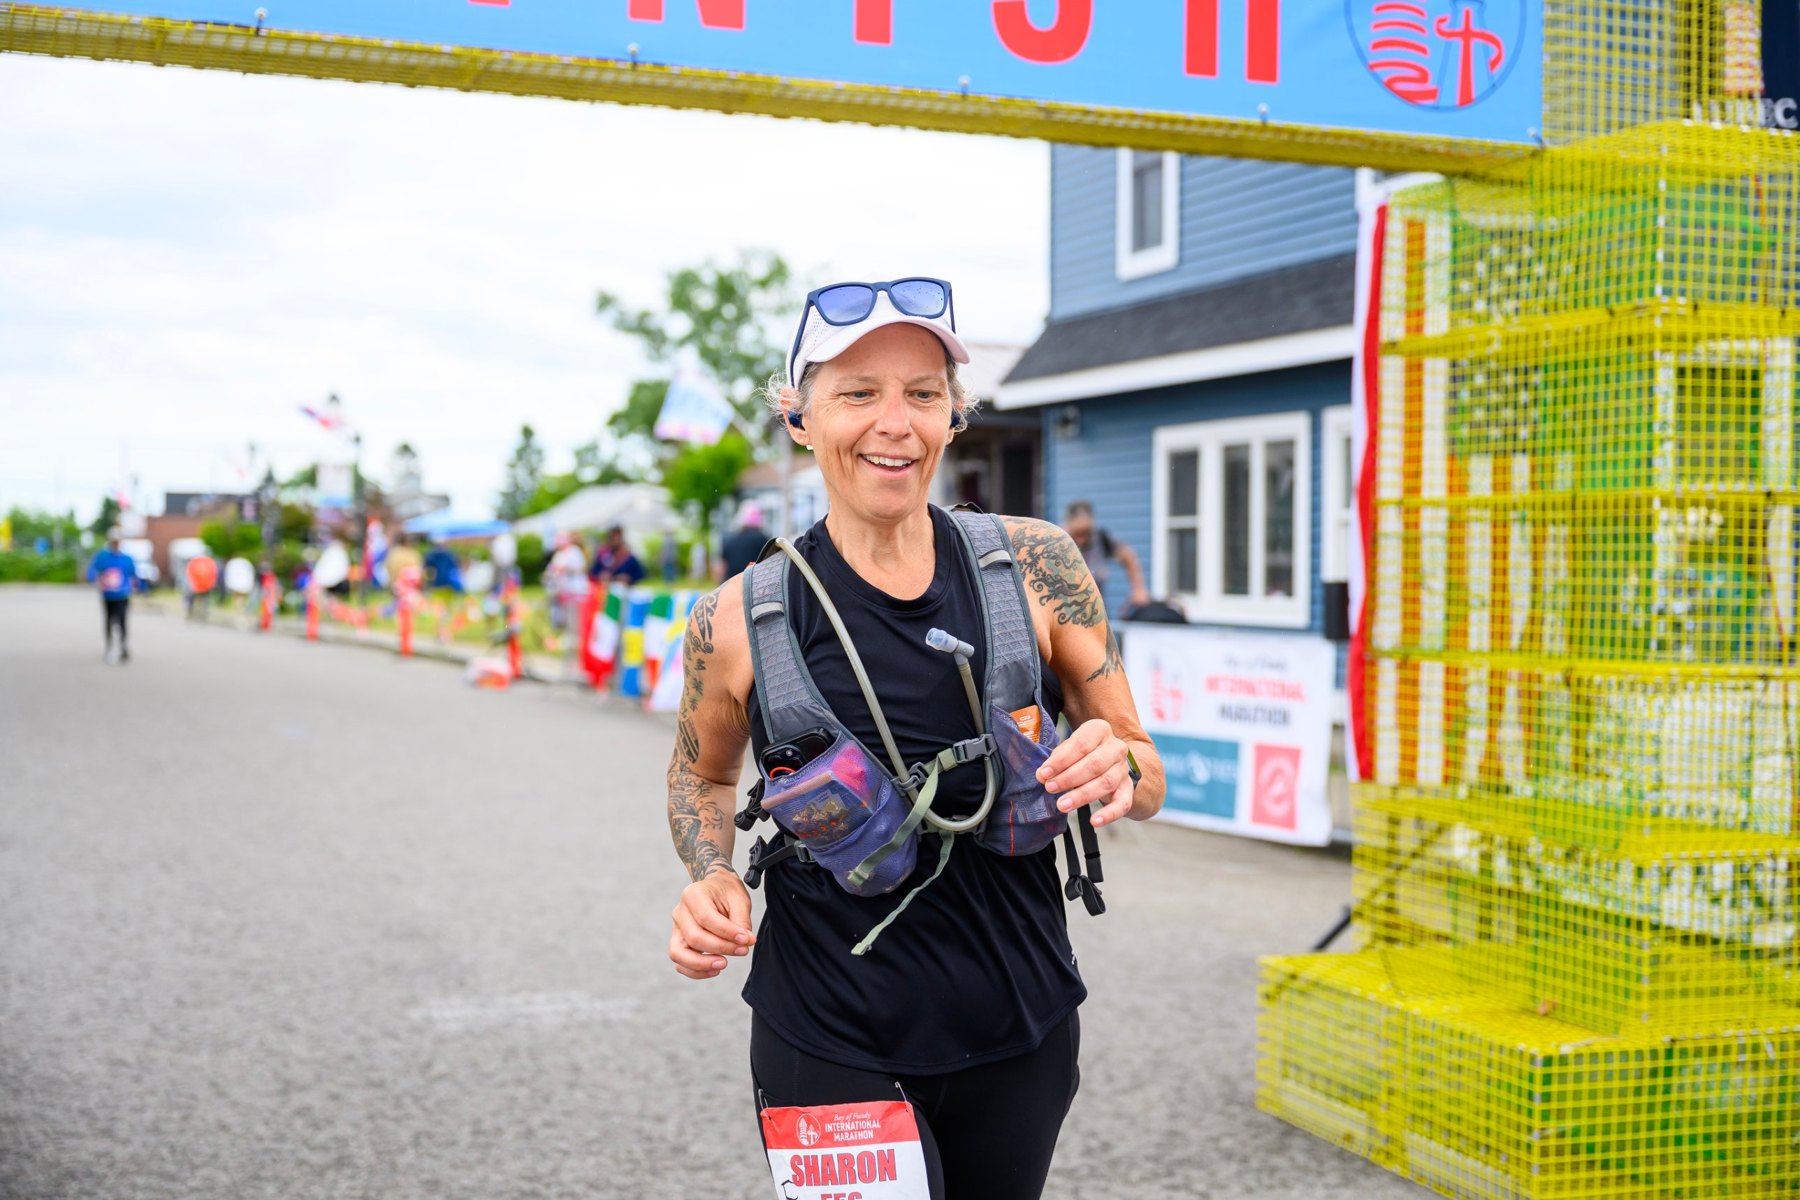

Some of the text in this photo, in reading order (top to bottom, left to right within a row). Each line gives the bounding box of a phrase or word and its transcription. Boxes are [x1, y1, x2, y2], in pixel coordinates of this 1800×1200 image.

[834, 1113, 844, 1122] Bay
[852, 1111, 871, 1121] Fundy
[825, 1119, 881, 1132] INTERNATIONAL
[834, 1129, 874, 1141] MARATHON
[790, 1148, 897, 1187] SHARON
